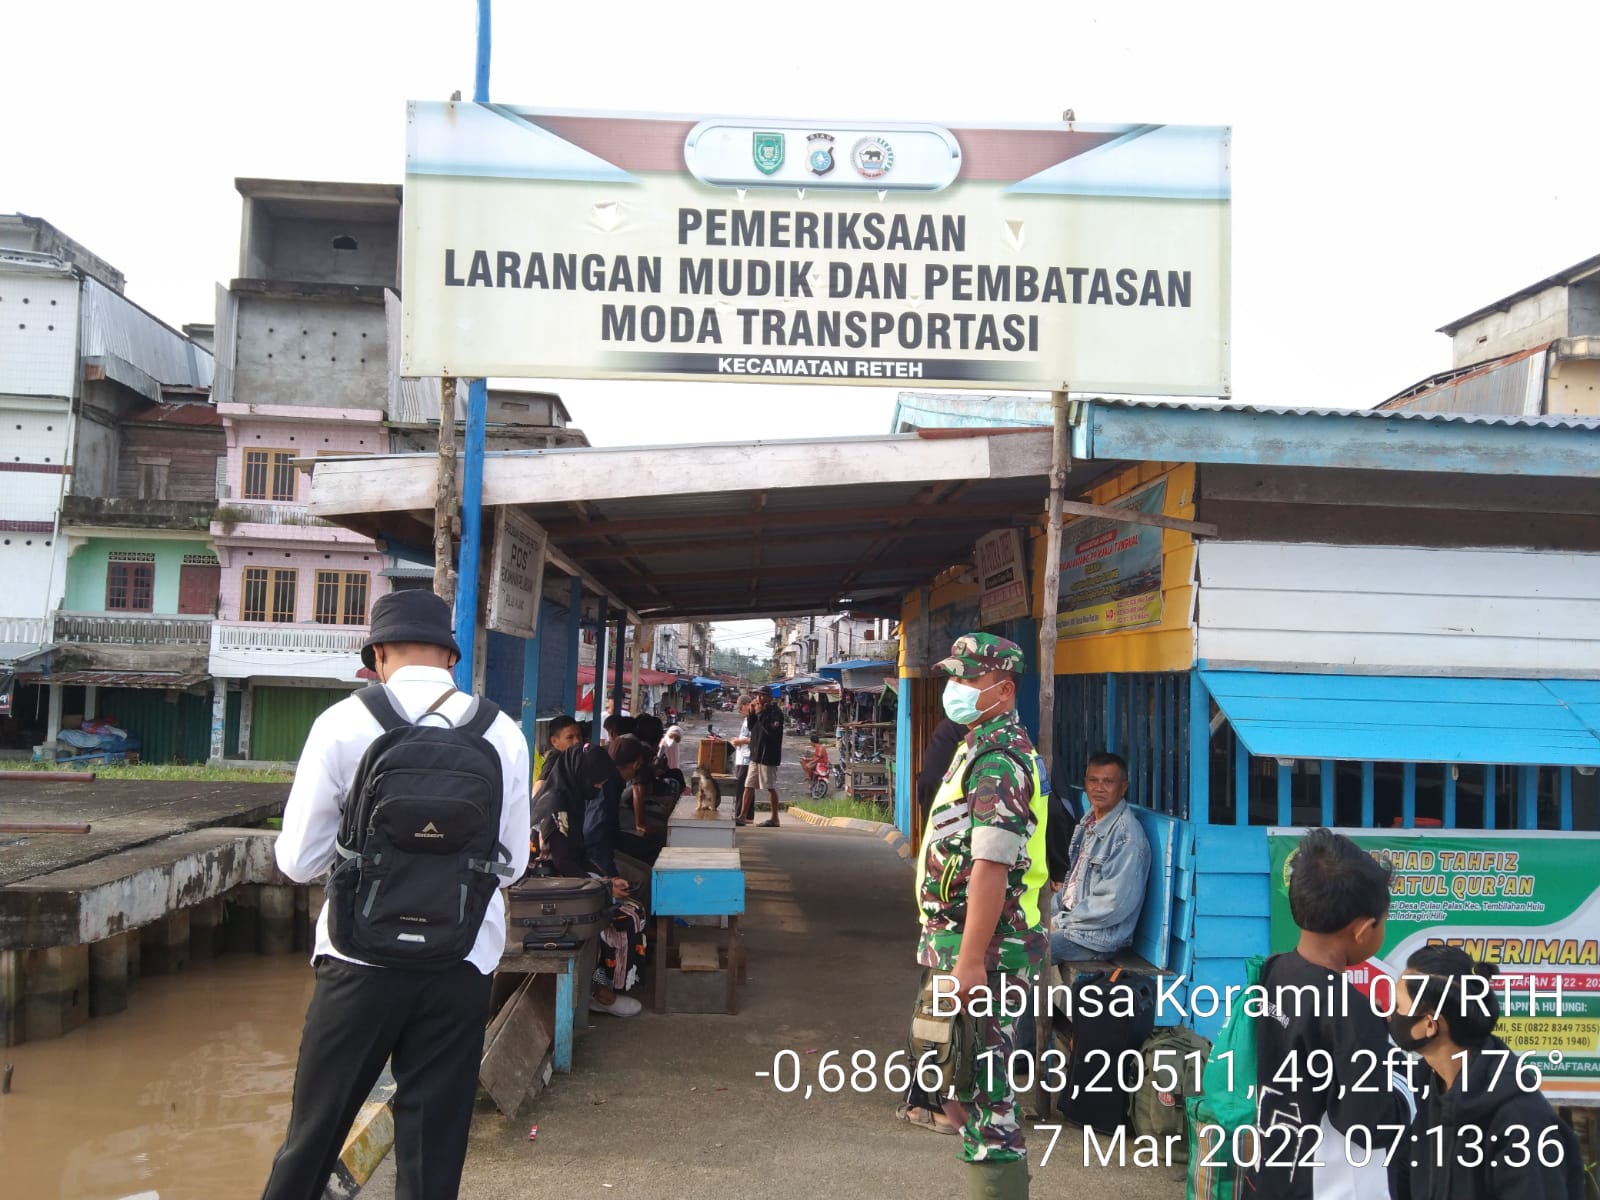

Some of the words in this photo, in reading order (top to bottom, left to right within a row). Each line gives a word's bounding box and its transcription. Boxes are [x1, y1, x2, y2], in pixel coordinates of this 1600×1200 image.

[678, 208, 965, 252] PEMERIKSAAN
[445, 249, 661, 293] LARANGAN
[679, 258, 815, 299] MUDIK
[829, 262, 907, 300] DAN
[925, 263, 1191, 308] PEMBATASAN
[602, 304, 722, 344] MODA
[736, 309, 1038, 352] TRANSPORTASI
[718, 357, 849, 376] KECAMATAN
[855, 360, 923, 378] RETEH
[511, 543, 528, 570] POS
[1439, 850, 1519, 872] TAHFIZ
[1453, 875, 1534, 900] QUR'AN
[1397, 911, 1428, 922] Indragiri
[1430, 911, 1447, 920] Hilir
[1400, 901, 1418, 911] Desa
[1420, 901, 1441, 911] Pulau
[1443, 902, 1463, 911] Palas
[1464, 902, 1481, 911] Kec.
[1483, 902, 1526, 911] Tembilahan
[1526, 903, 1545, 912] Hulu
[1551, 977, 1576, 987] 222
[1542, 1002, 1588, 1012] HUUNGI:
[1511, 1022, 1522, 1031] SE
[1524, 1022, 1549, 1033] (0822
[1551, 1023, 1573, 1032] 8349
[1576, 1023, 1600, 1034] 7355)
[1515, 1036, 1540, 1047] (0852
[1542, 1036, 1564, 1046] 7126
[1567, 1037, 1590, 1047] 1940)
